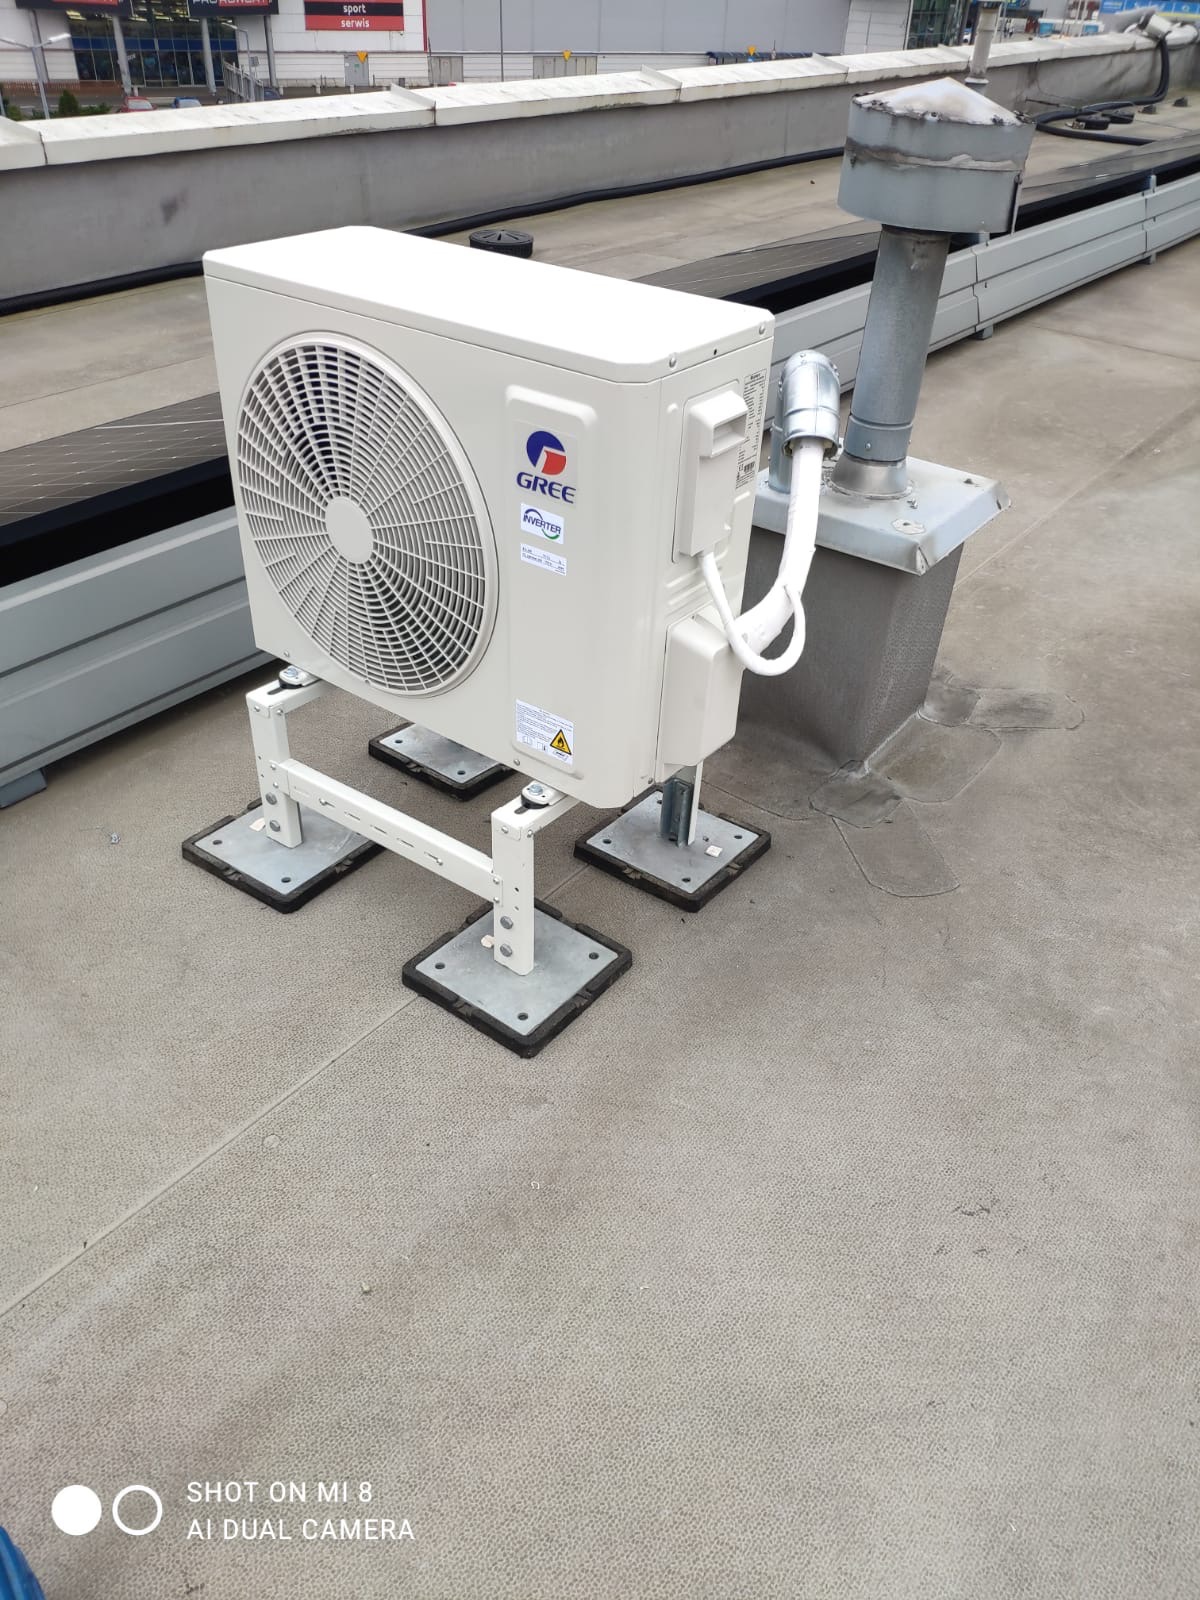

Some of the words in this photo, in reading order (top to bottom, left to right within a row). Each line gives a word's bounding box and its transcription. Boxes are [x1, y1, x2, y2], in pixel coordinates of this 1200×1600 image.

[343, 4, 366, 16] sport
[341, 18, 370, 28] serwis
[516, 471, 577, 504] GREE
[523, 514, 562, 535] INVERTER
